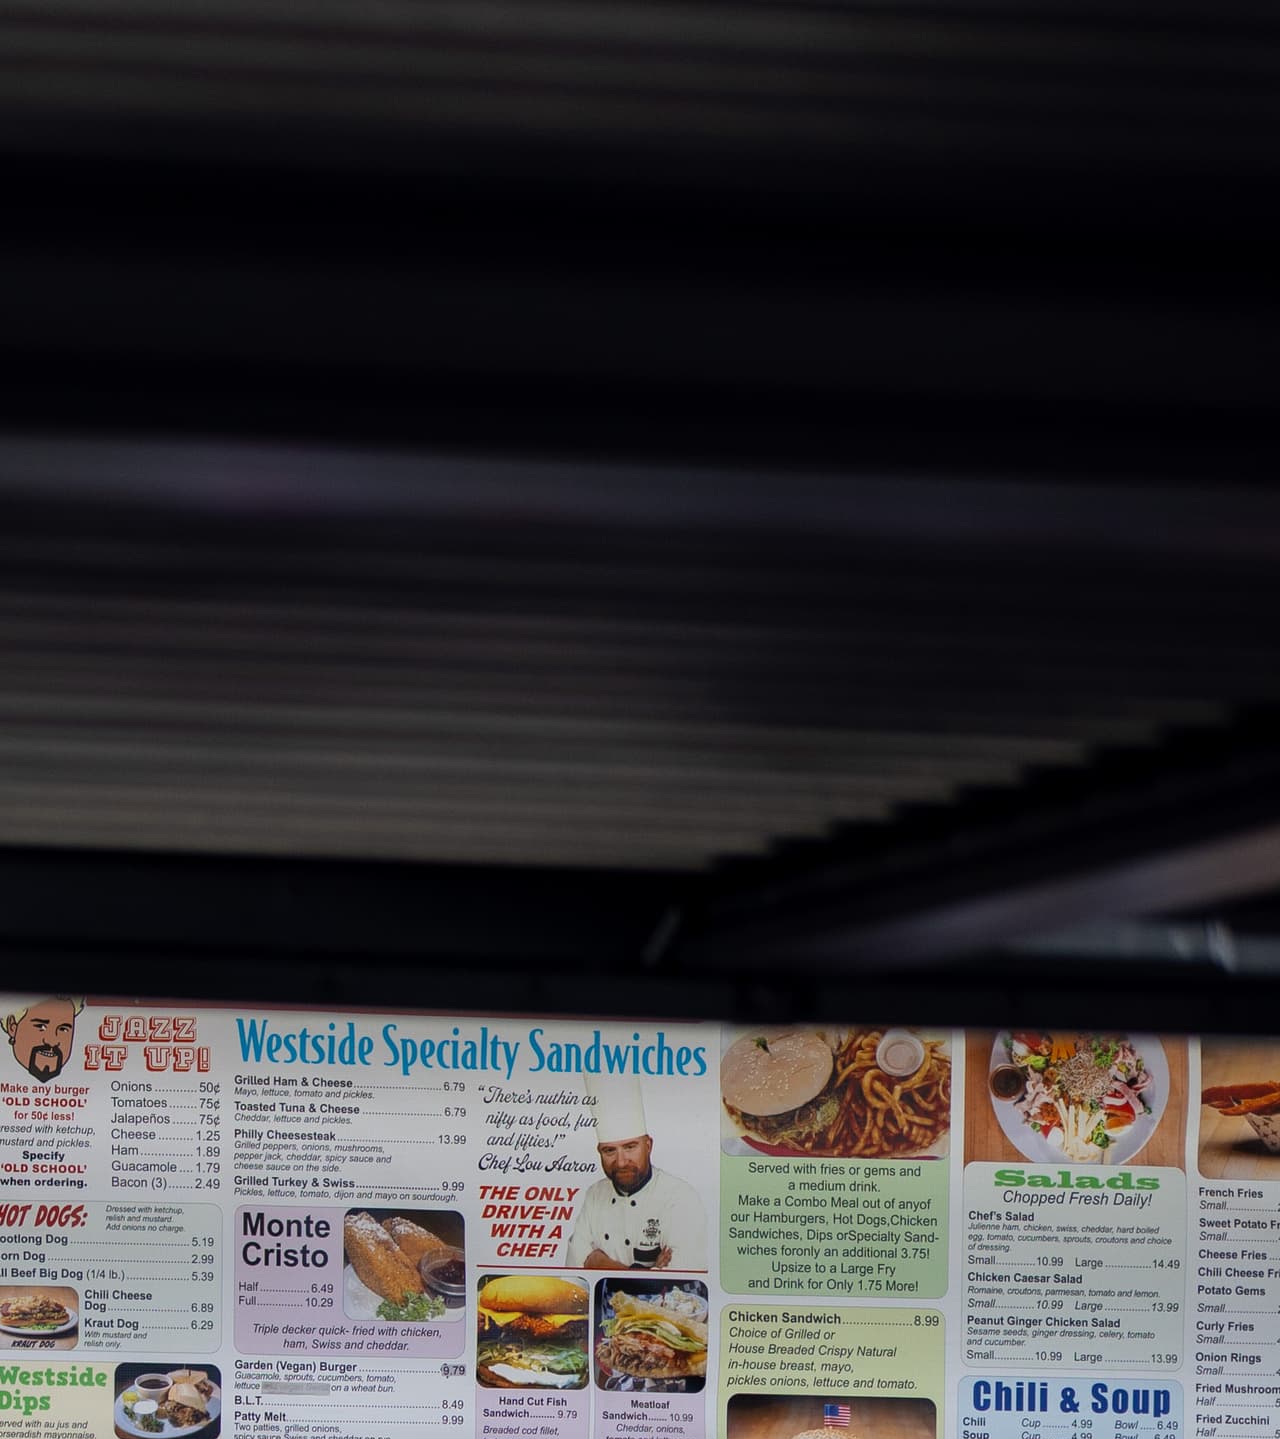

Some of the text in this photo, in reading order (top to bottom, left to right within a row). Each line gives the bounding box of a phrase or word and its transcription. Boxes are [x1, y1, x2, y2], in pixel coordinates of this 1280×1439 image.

[99, 1016, 196, 1043] JAZZ
[84, 1045, 210, 1072] IT UP!
[235, 1017, 708, 1081] Westside Specialty Sandwiches
[111, 1080, 152, 1092] Onions
[111, 1113, 170, 1126] Jalapeños
[111, 1128, 220, 1141] Cheese 1.25
[994, 1169, 1160, 1190] Salads
[478, 1185, 580, 1202] THE ONLY
[1002, 1190, 1152, 1209] Chopped Fresh Daily!
[34, 1205, 88, 1227] DOGS:
[482, 1204, 574, 1221] DRIVE-IN
[243, 1212, 330, 1238] Monte
[491, 1223, 562, 1239] WITH A
[243, 1242, 328, 1268] Cristo
[497, 1242, 558, 1258] CHEF!
[973, 1380, 1170, 1418] Chili & Soup
